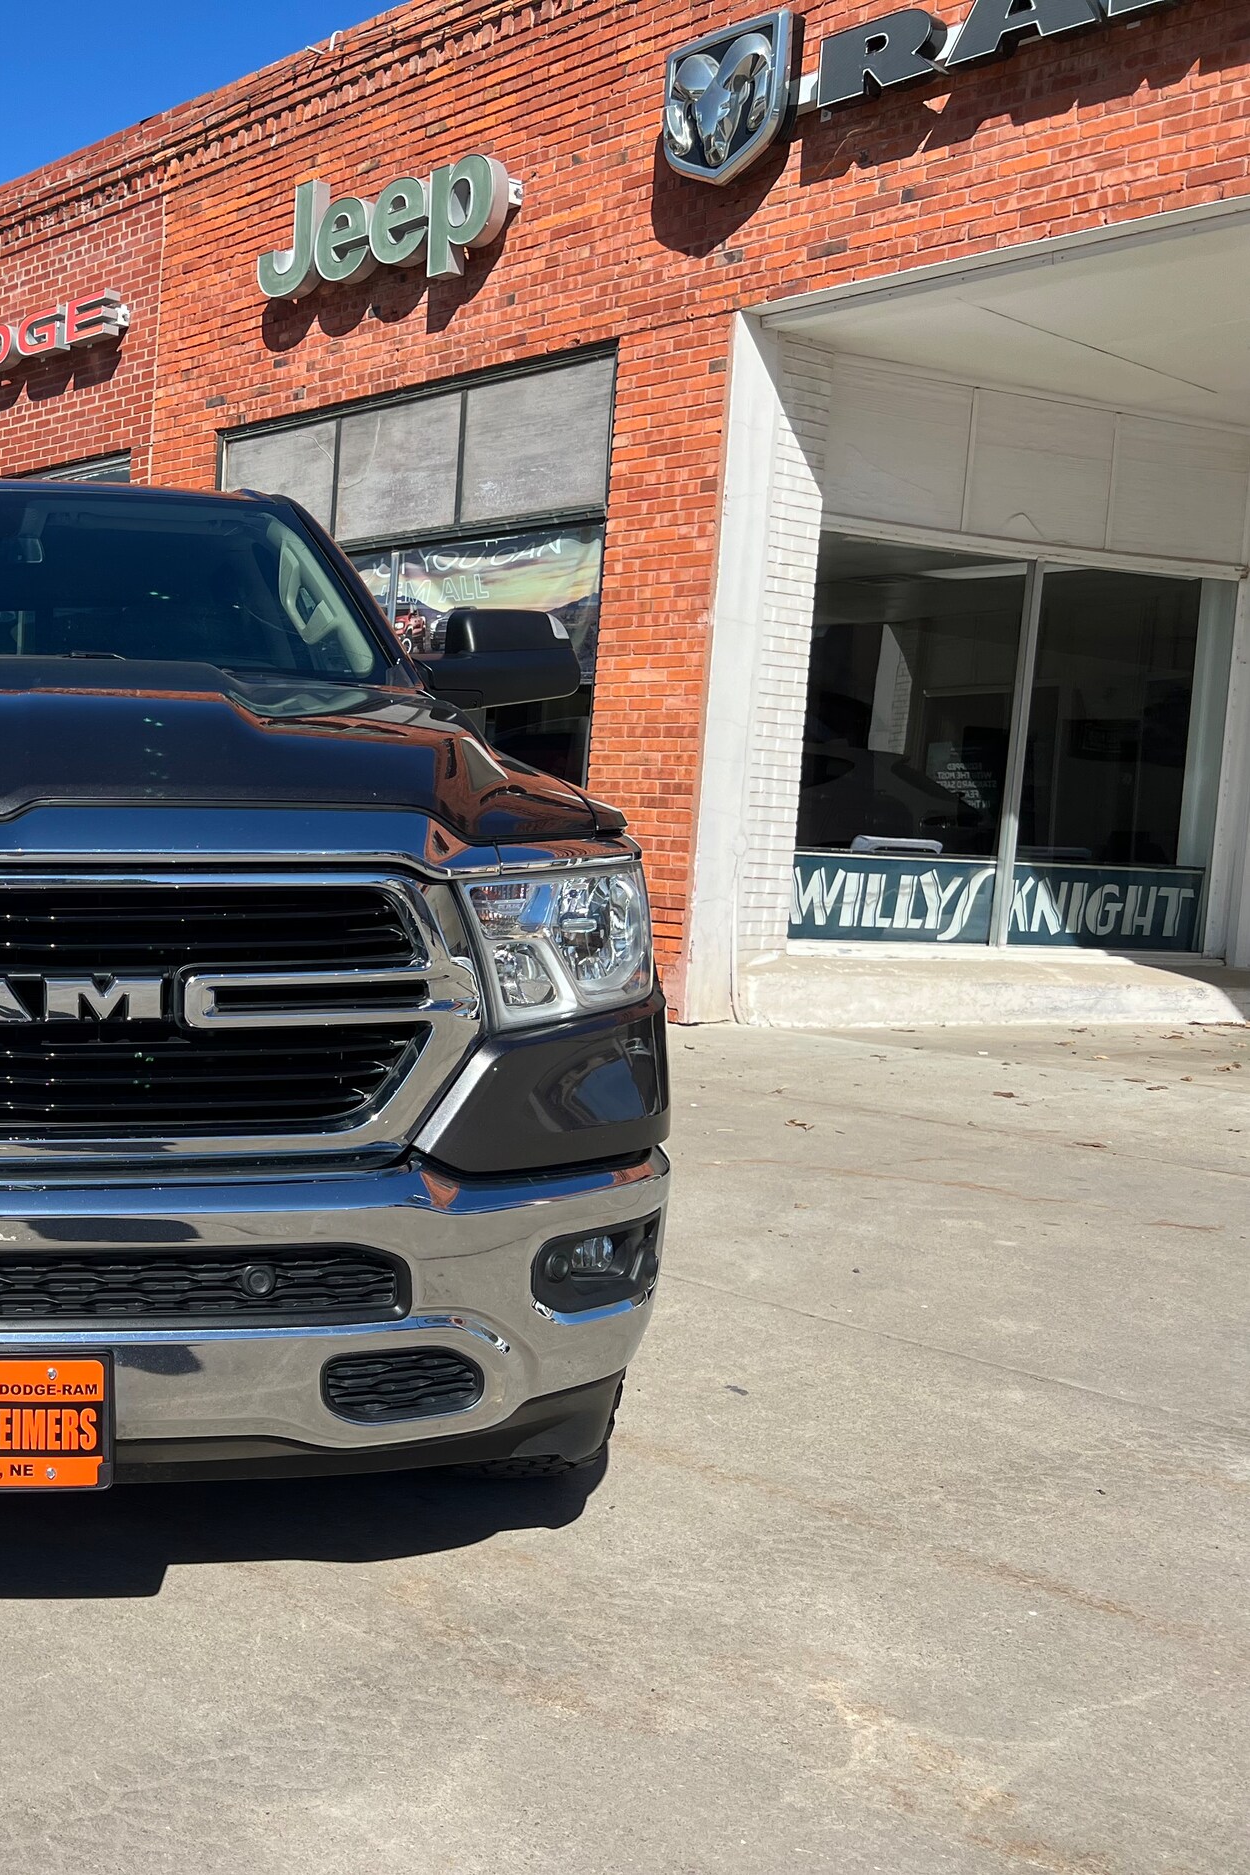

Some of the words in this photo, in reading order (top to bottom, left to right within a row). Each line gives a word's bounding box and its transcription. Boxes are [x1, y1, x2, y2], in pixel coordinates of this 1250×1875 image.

[817, 0, 1166, 107] RA
[257, 153, 506, 298] Jeep
[419, 546, 482, 573] YOU
[490, 530, 563, 567] CAN
[438, 574, 490, 604] ALL
[789, 866, 996, 941] WILLYS
[1008, 872, 1196, 938] KNIGHT
[9, 1464, 34, 1477] NE
